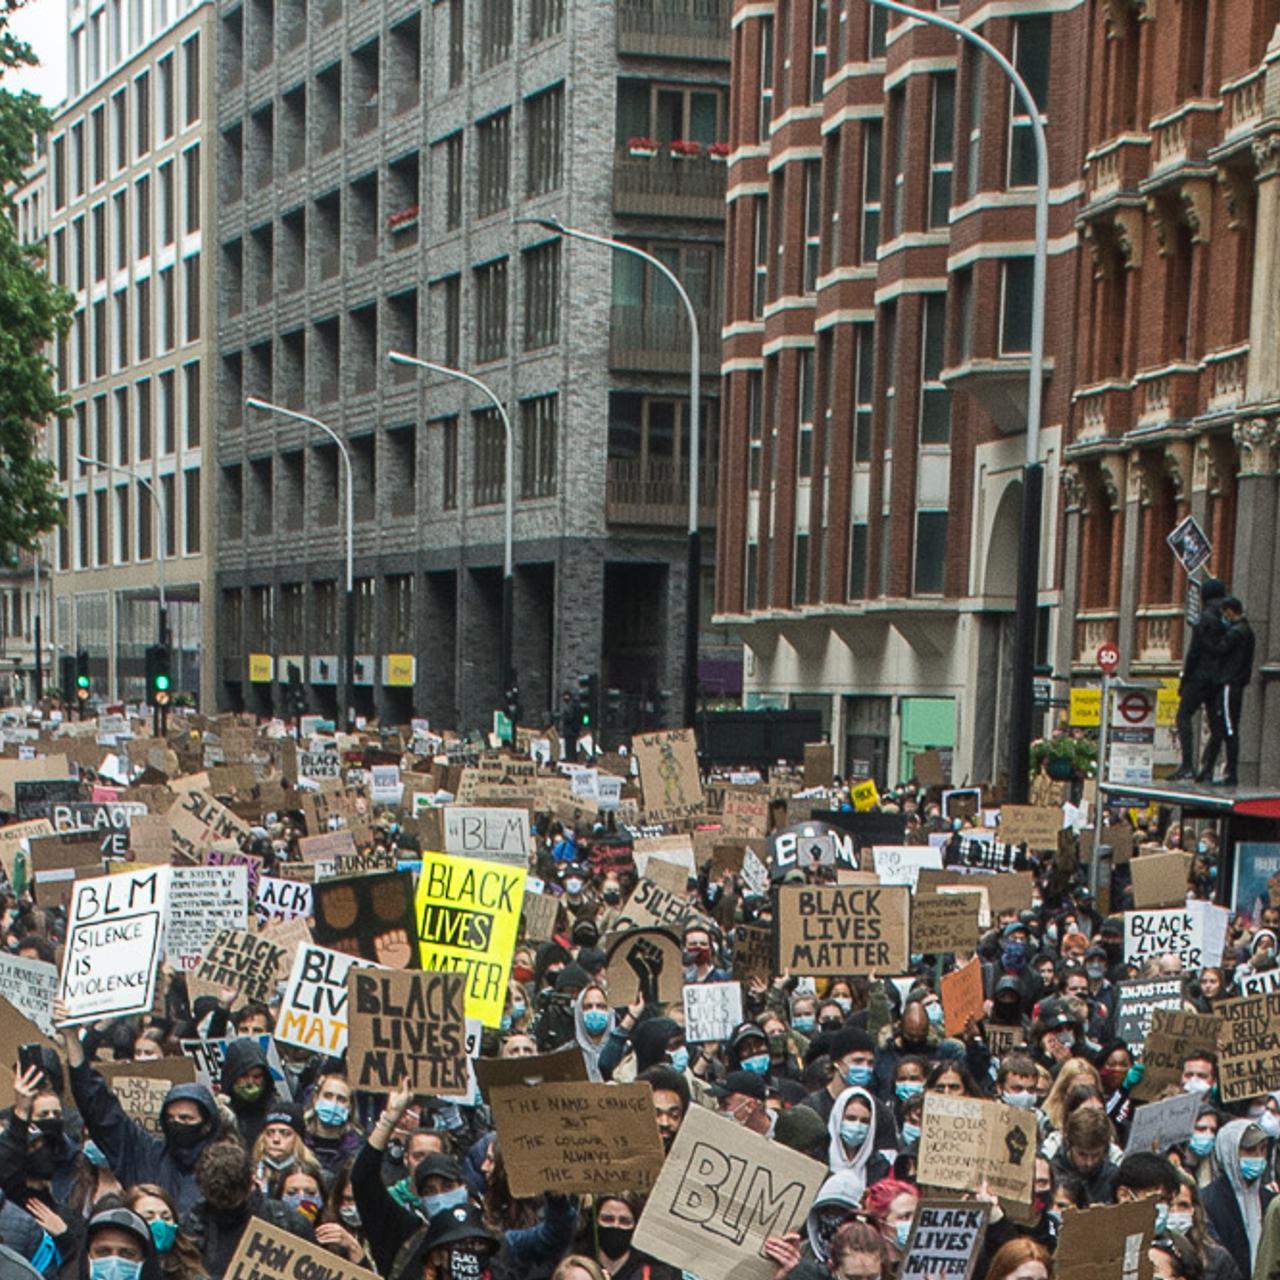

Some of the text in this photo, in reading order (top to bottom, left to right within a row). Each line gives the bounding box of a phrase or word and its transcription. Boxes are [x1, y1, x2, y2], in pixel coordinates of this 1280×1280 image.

[76, 873, 157, 921] BLM
[427, 863, 520, 913] BLACK
[798, 889, 881, 916] BLACK
[75, 922, 143, 952] SILENCE
[423, 906, 492, 951] LIVES
[802, 918, 881, 941] LIVES
[1131, 914, 1194, 937] BLACK
[791, 941, 889, 970] MATTER
[1136, 933, 1191, 953] LIVES
[75, 955, 91, 976] IS
[66, 970, 145, 997] VIOLENCE
[356, 974, 463, 1022] BLACK
[372, 1017, 460, 1057] LIVES
[359, 1051, 467, 1088] MATTER
[668, 1141, 806, 1251] BLM
[920, 1210, 981, 1228] BLACK
[913, 1233, 972, 1251] LIVES
[905, 1257, 967, 1275] MATTER
